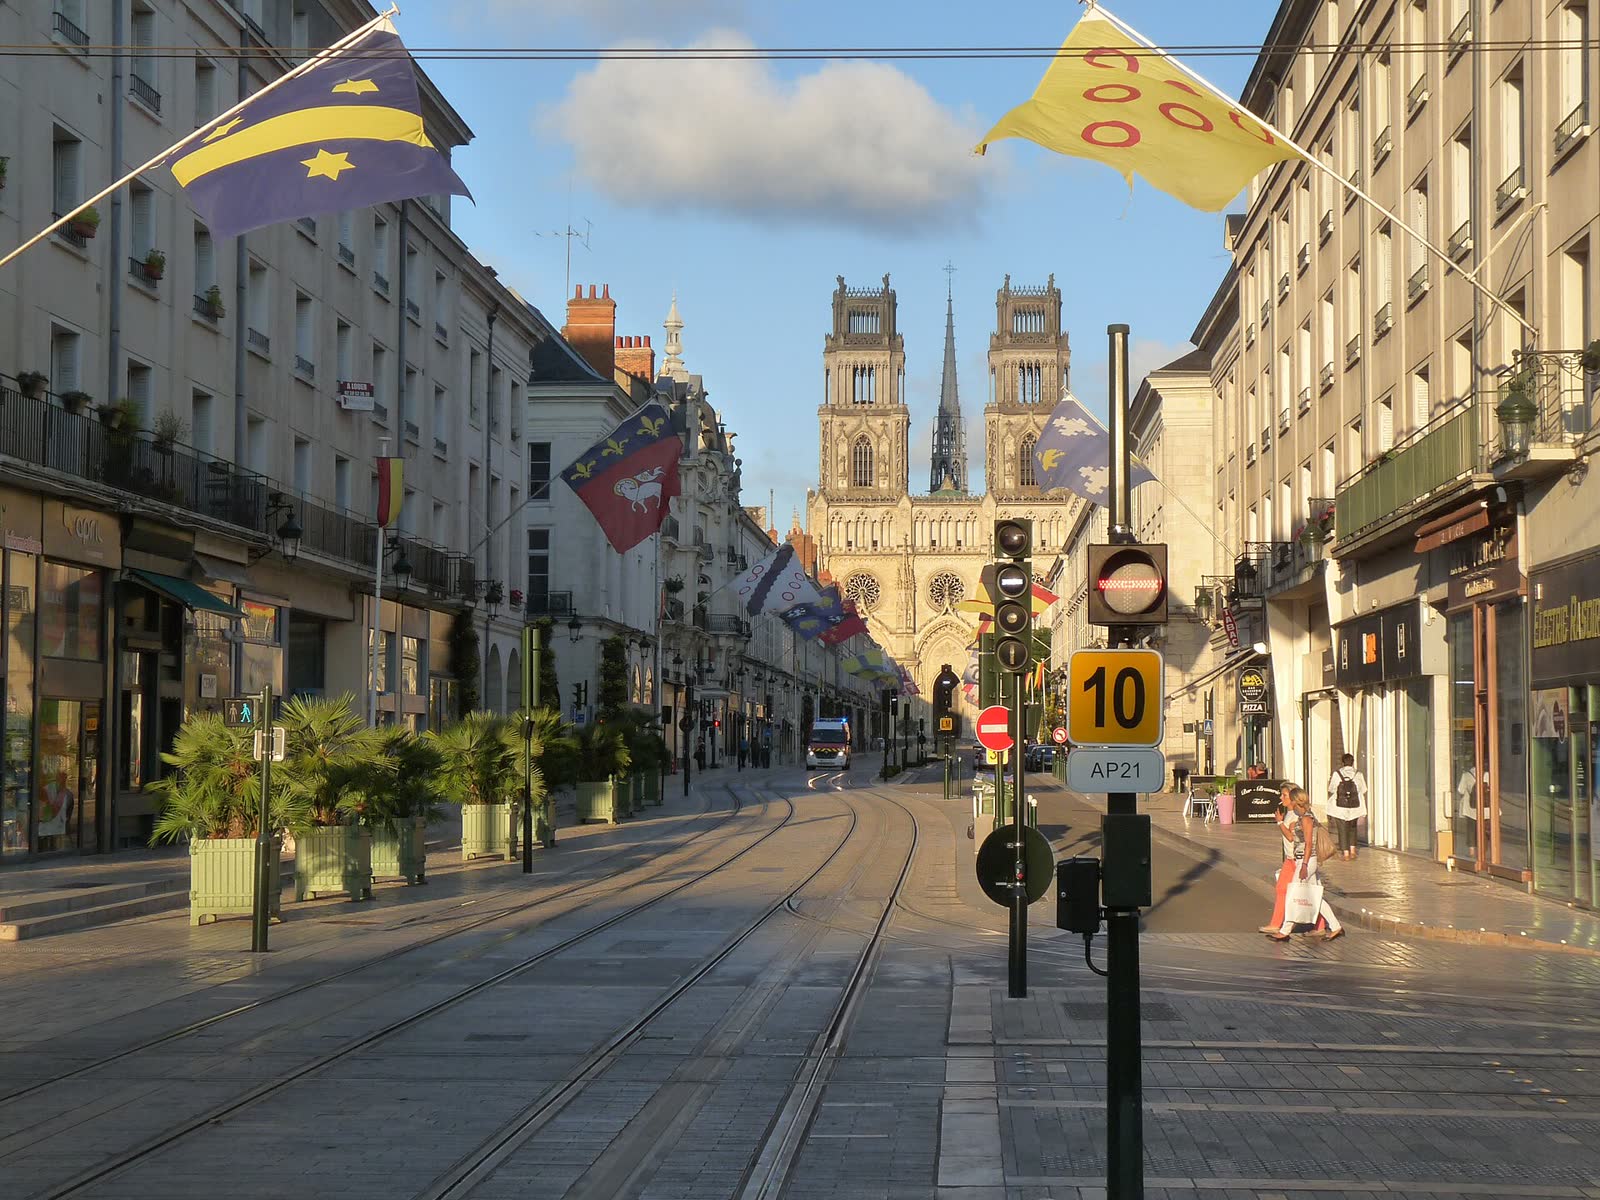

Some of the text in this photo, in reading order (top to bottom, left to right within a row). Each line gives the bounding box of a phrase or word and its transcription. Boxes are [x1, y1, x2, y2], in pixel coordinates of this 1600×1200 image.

[1223, 609, 1238, 646] TABAC
[1083, 666, 1146, 729] 10
[1091, 762, 1140, 778] AP21
